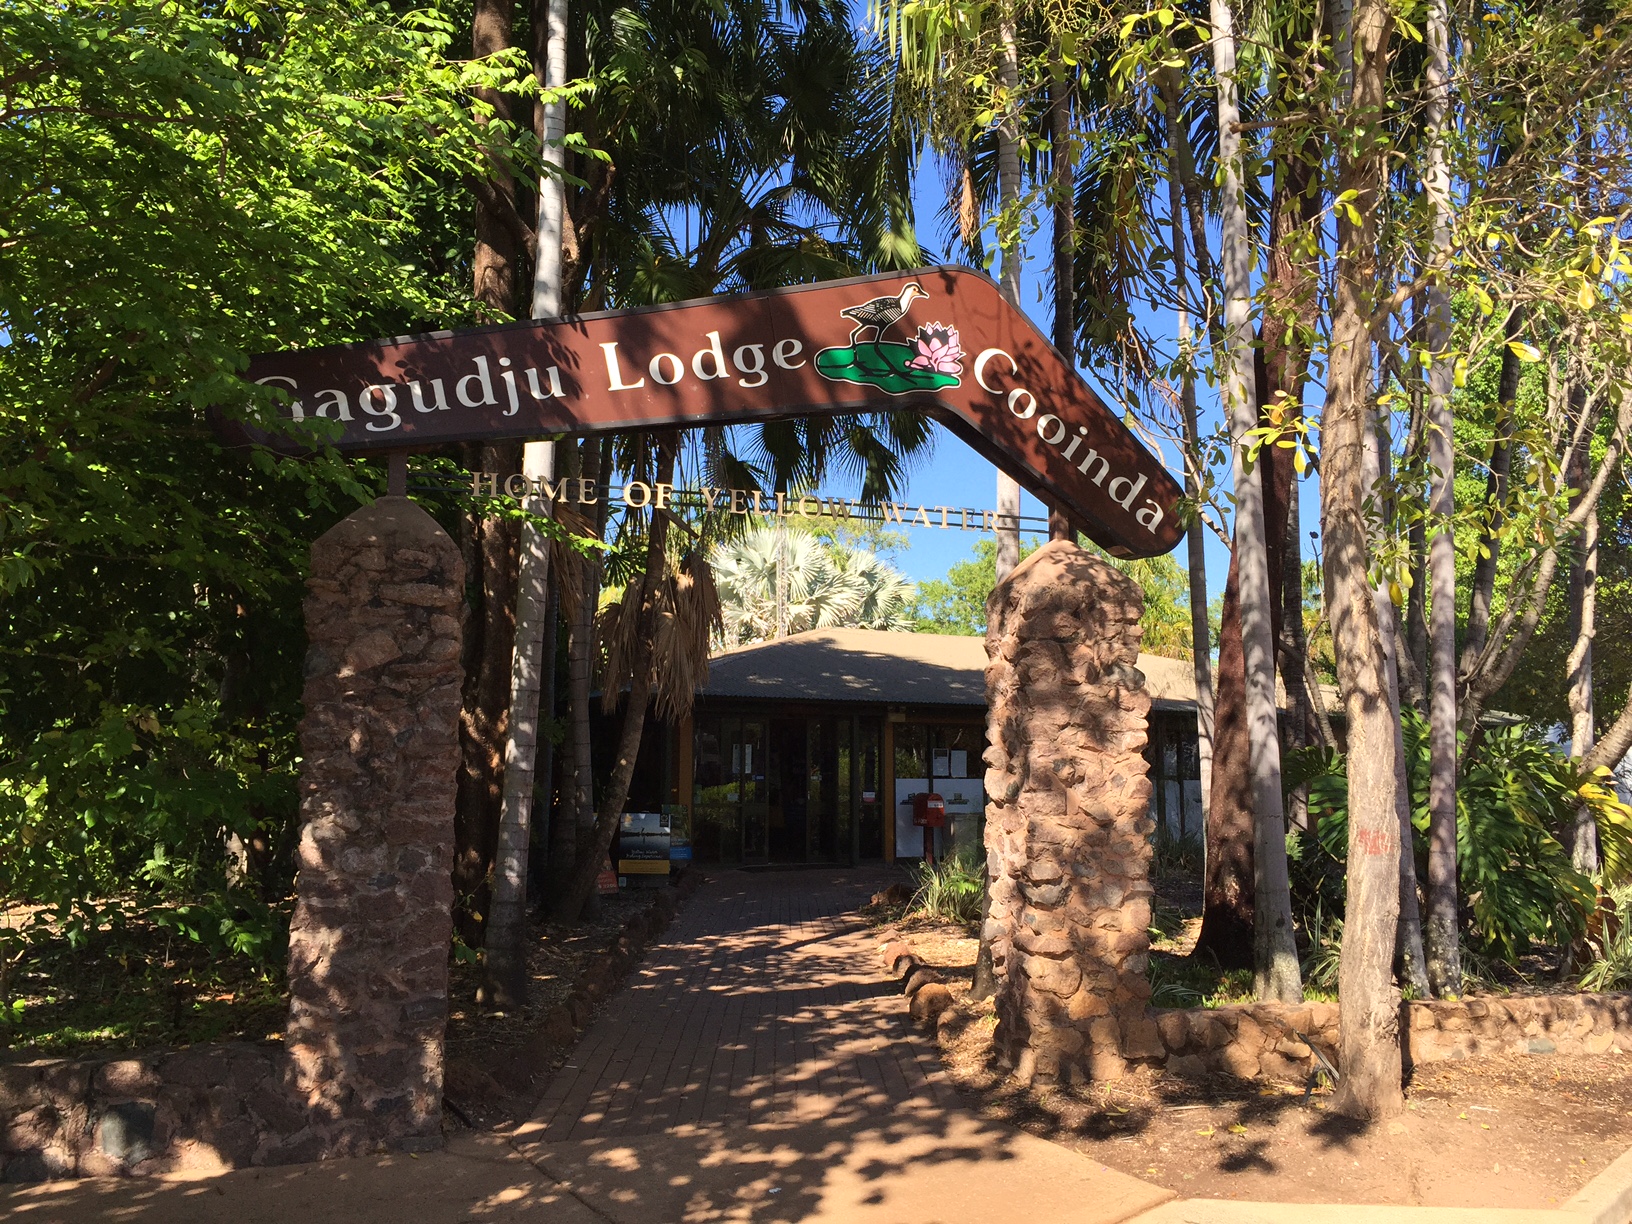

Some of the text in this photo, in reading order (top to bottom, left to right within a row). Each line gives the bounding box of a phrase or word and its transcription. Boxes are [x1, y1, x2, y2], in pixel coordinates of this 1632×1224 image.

[245, 331, 1165, 535] Gagudju Lodge Cooinda
[471, 471, 1001, 534] HOME OF YELLOW WATER
